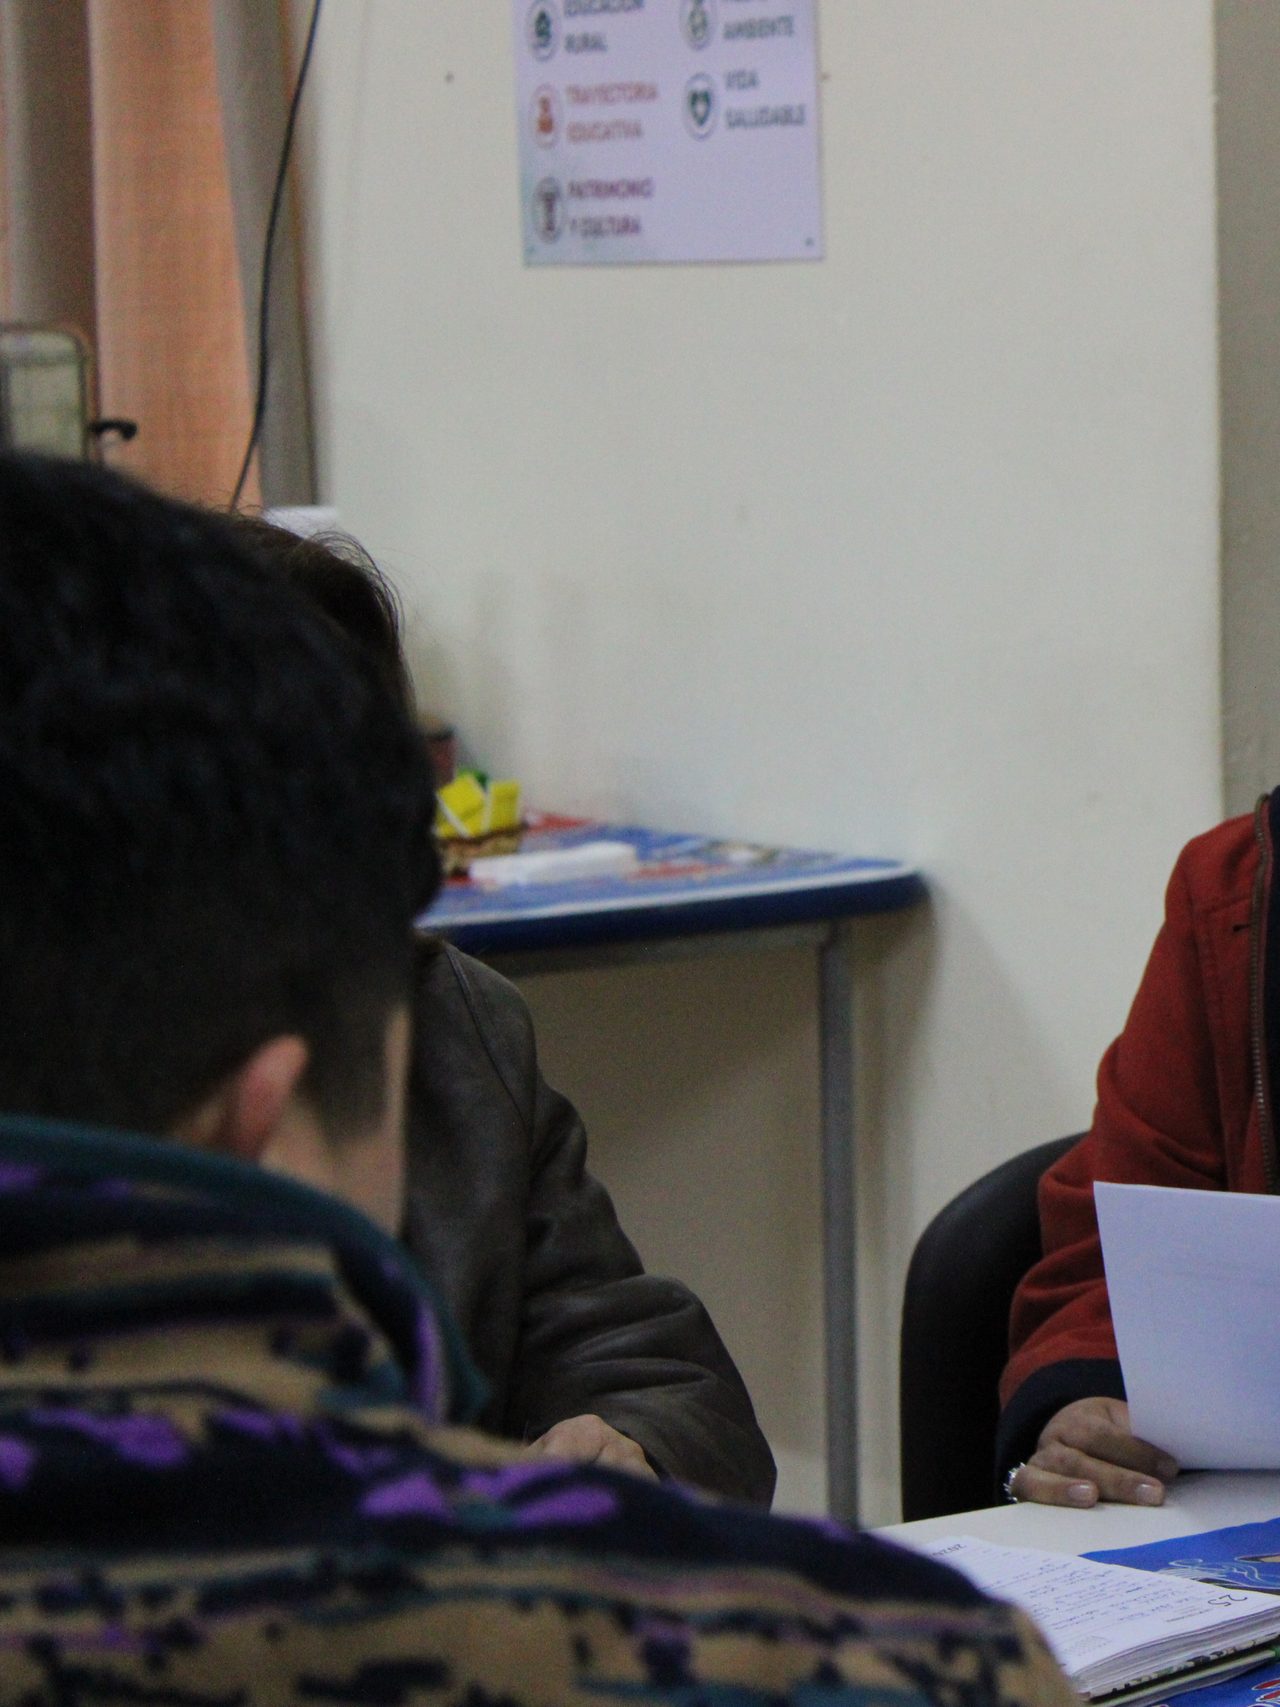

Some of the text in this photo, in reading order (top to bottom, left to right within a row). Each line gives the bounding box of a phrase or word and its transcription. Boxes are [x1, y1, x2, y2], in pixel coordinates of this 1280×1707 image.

[723, 15, 795, 39] AMBIENTE
[564, 32, 608, 53] RURAL
[725, 69, 759, 90] VIDA
[726, 104, 806, 129] SALUDABLE
[567, 119, 643, 144] EDUCATIVA
[567, 177, 654, 200] PATRIMONIO
[580, 214, 641, 238] CULTURA
[1207, 1594, 1248, 1607] 25
